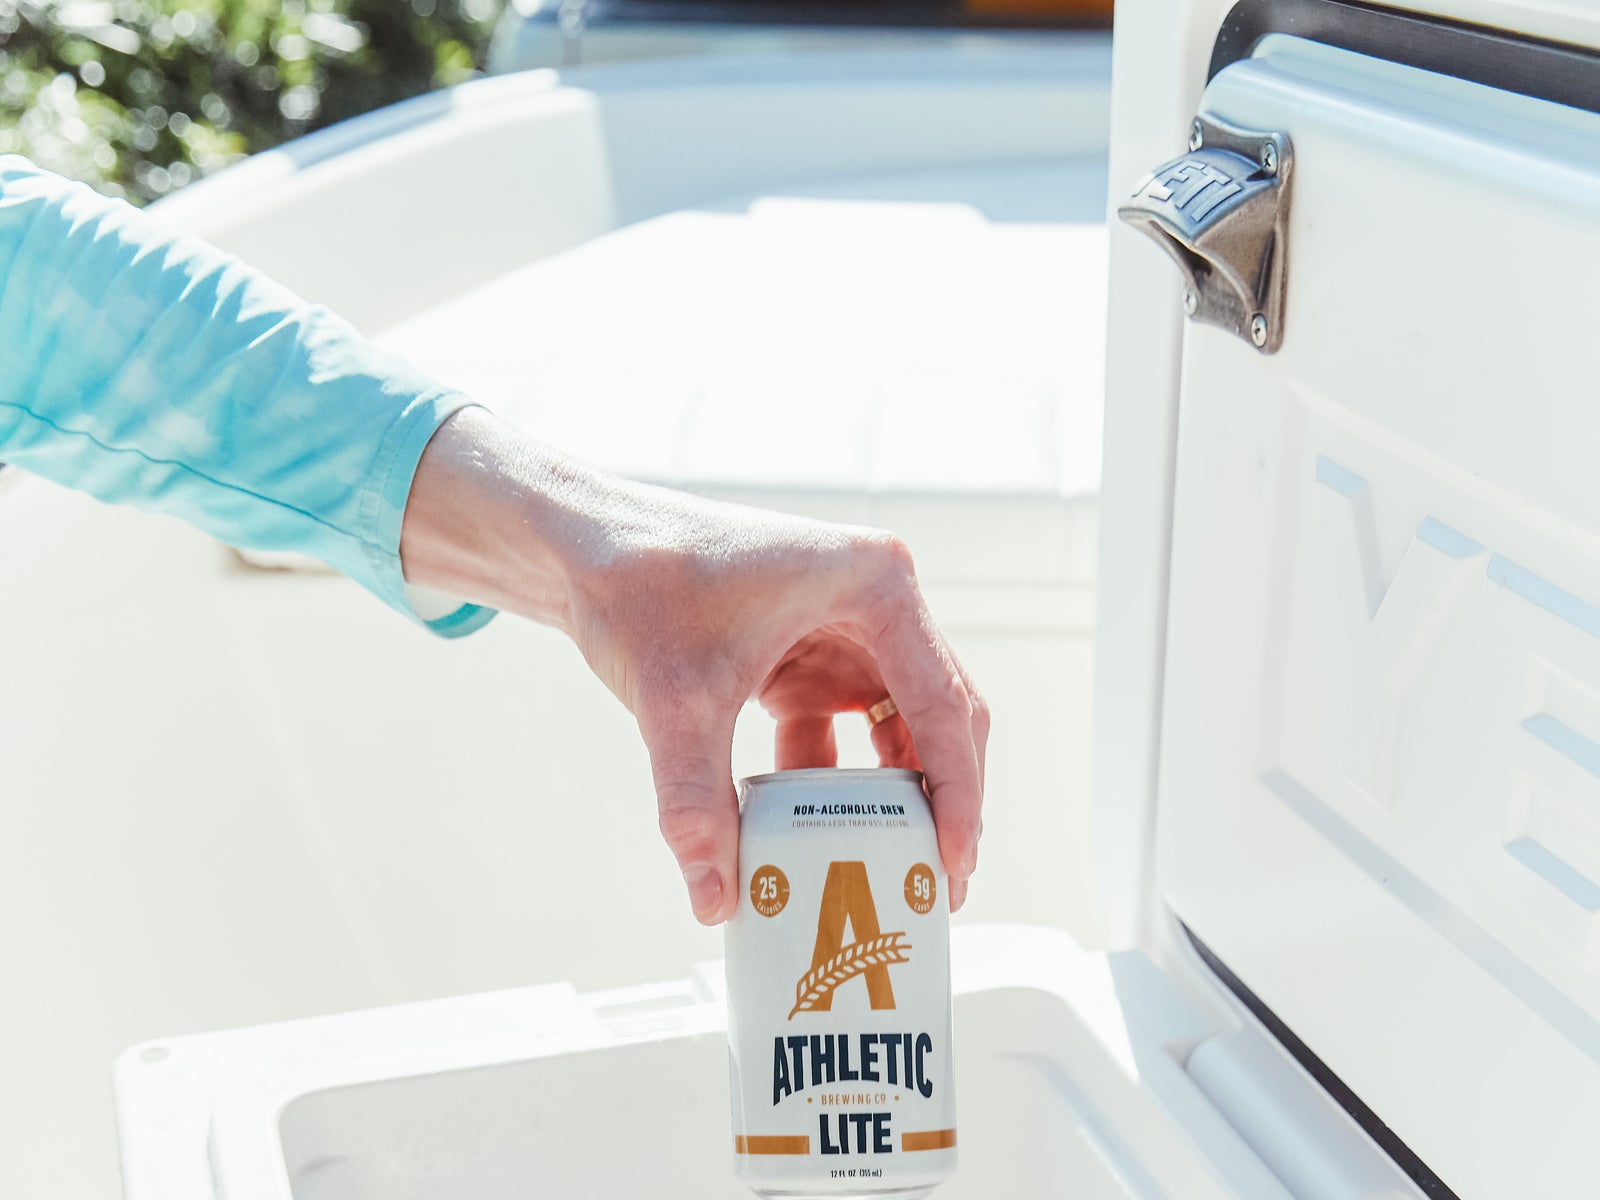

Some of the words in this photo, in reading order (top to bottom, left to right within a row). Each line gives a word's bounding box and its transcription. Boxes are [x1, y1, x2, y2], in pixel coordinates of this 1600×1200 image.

[793, 804, 878, 816] NON-ALCOHOLIC
[880, 804, 905, 816] BREW
[792, 819, 826, 829] CONTAINS
[828, 819, 846, 828] LESS
[848, 818, 867, 828] THAN
[759, 876, 777, 900] 25
[913, 874, 930, 900] 5g
[756, 900, 783, 915] CALORIES
[790, 861, 902, 1016] A
[773, 1032, 933, 1106] ATHLETIC
[821, 1093, 871, 1106] BREWING
[819, 1112, 893, 1155] LITE
[831, 1169, 838, 1178] 12
[848, 1169, 856, 1178] OZ
